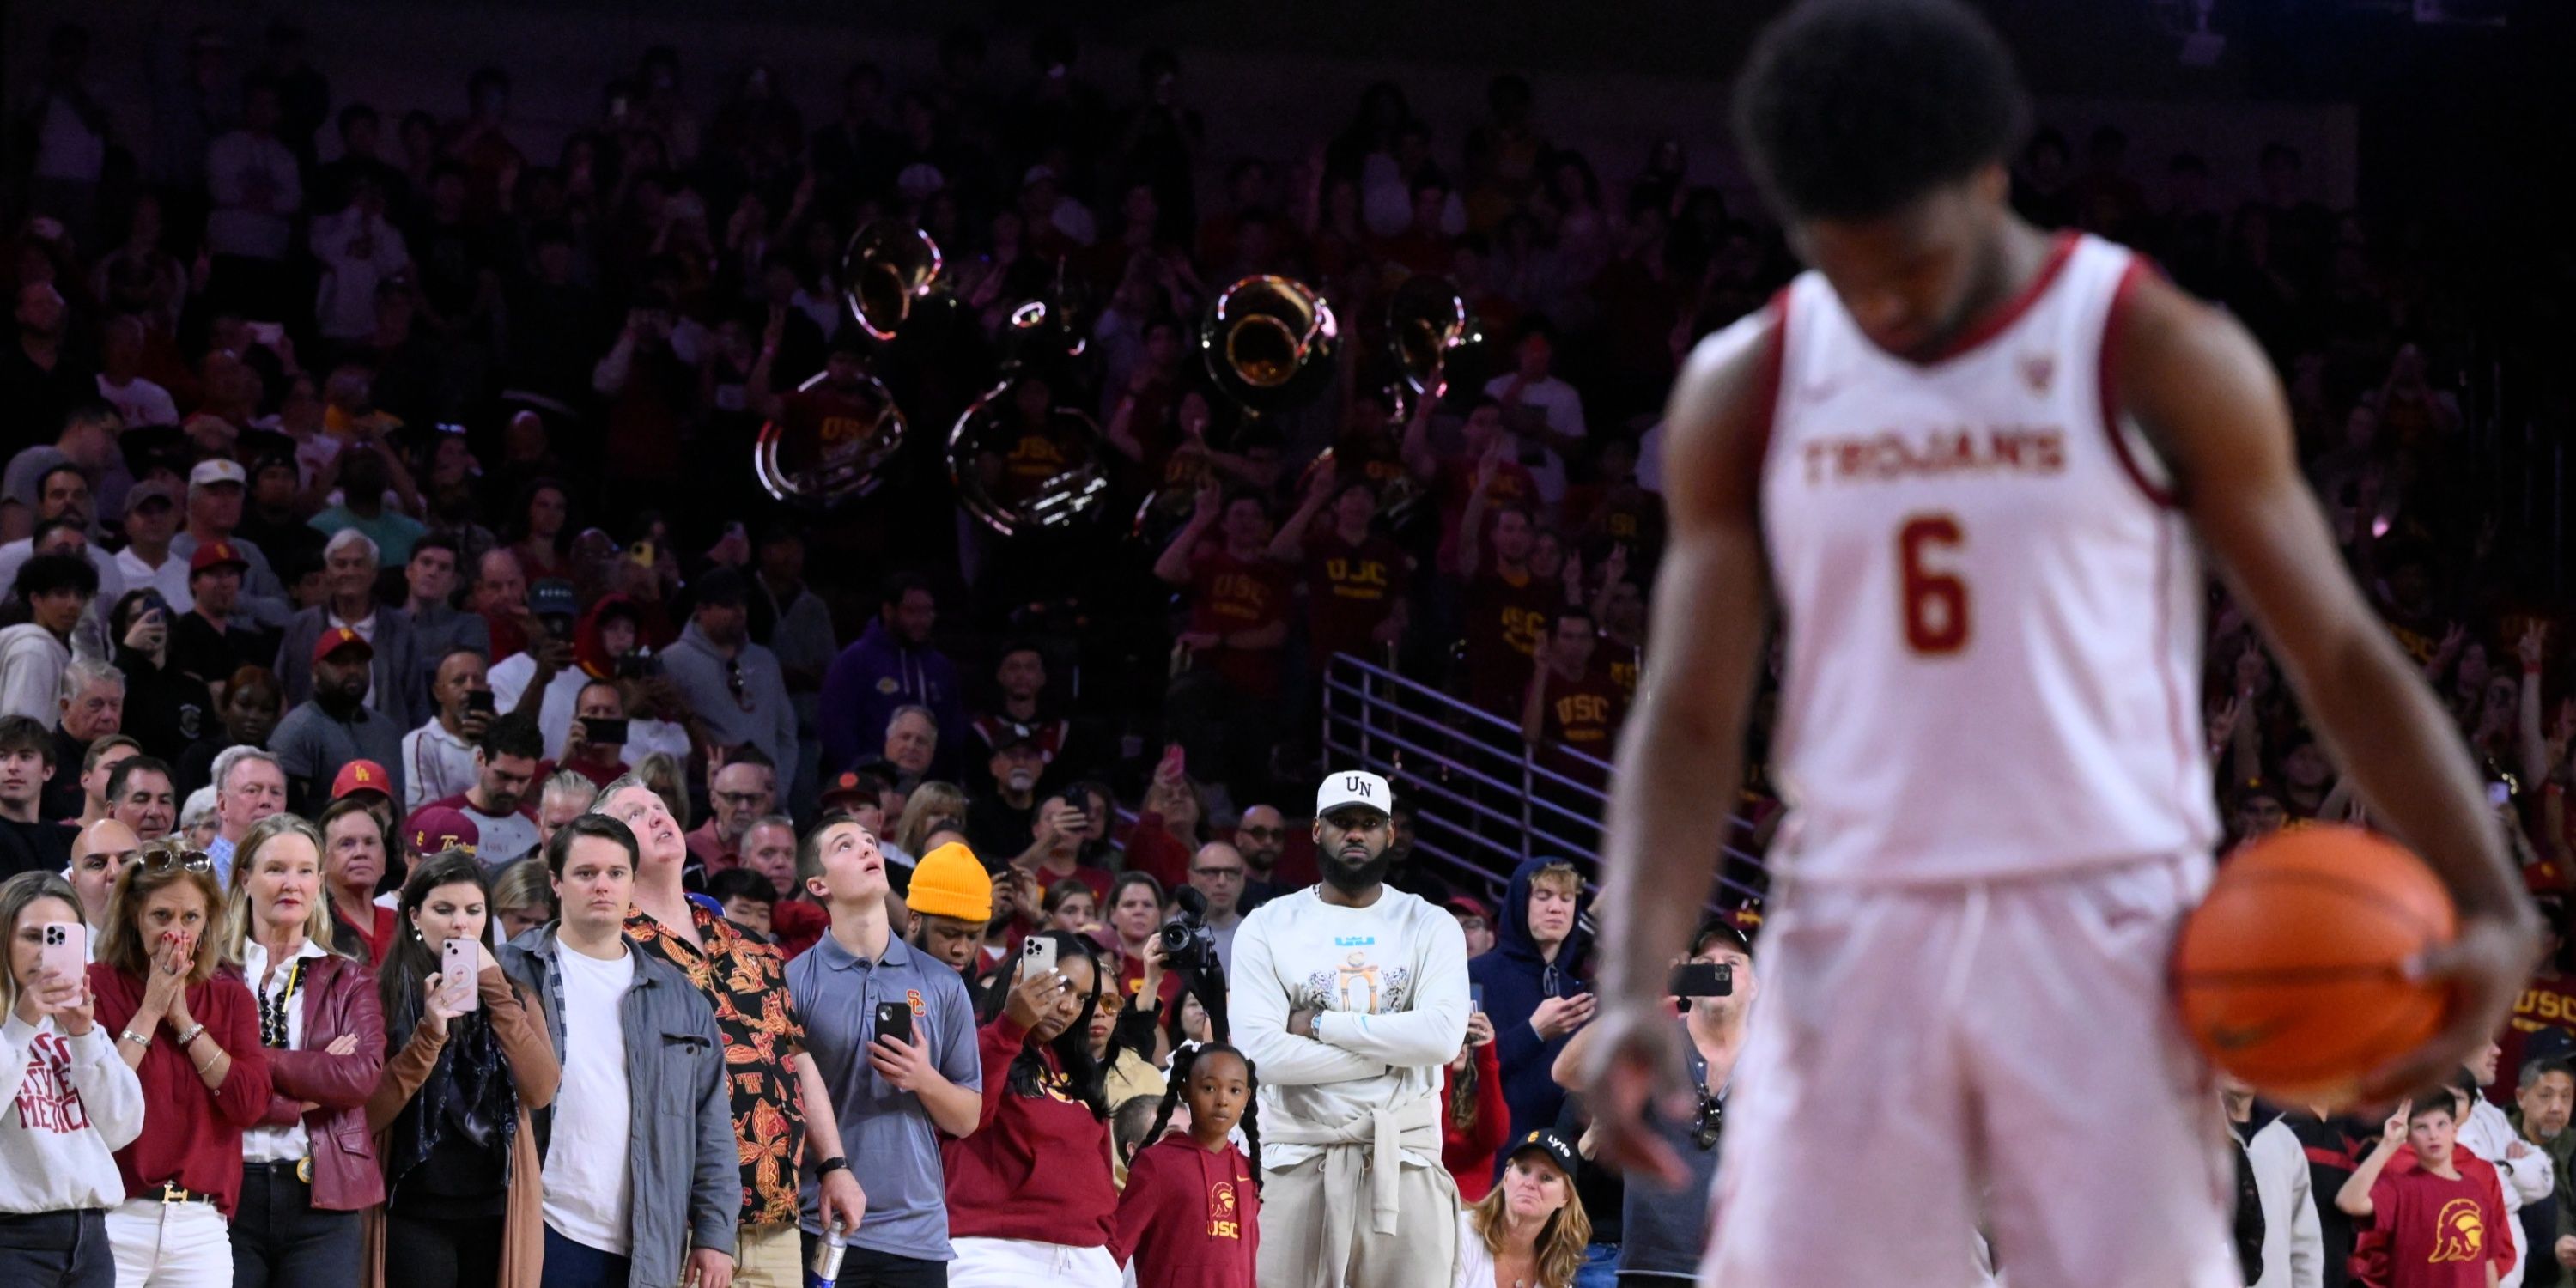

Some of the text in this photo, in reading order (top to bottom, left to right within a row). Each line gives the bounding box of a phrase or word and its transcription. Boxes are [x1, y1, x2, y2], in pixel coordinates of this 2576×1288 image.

[1805, 431, 2063, 483] TROJANS
[1899, 518, 1966, 653] 6
[1554, 692, 1611, 726] USC
[1206, 1220, 1239, 1240] USC
